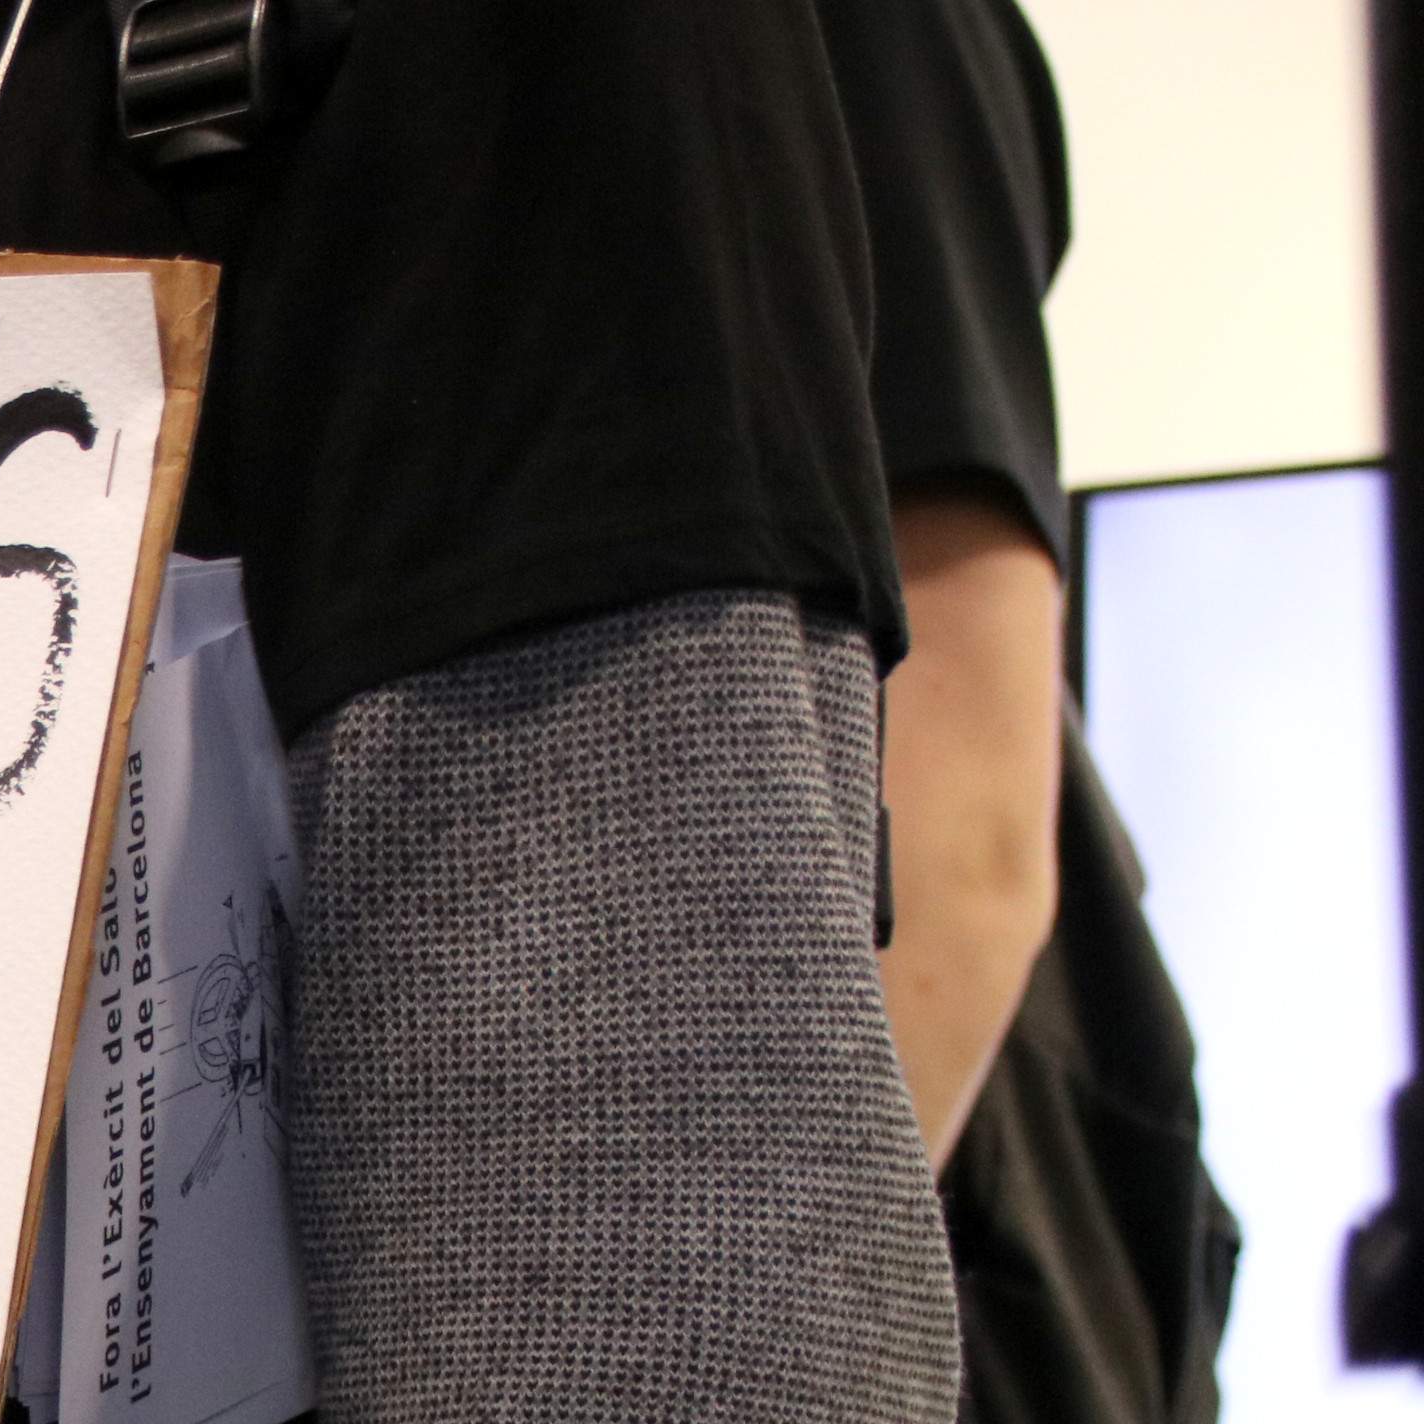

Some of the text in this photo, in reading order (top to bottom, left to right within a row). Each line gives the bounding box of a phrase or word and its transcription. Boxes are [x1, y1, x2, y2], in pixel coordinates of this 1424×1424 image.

[100, 989, 122, 1065] del
[127, 750, 158, 1404] l'Ensenyament de Barcelona
[101, 1080, 124, 1280] l'Exèrcit
[99, 1293, 121, 1393] Fora
